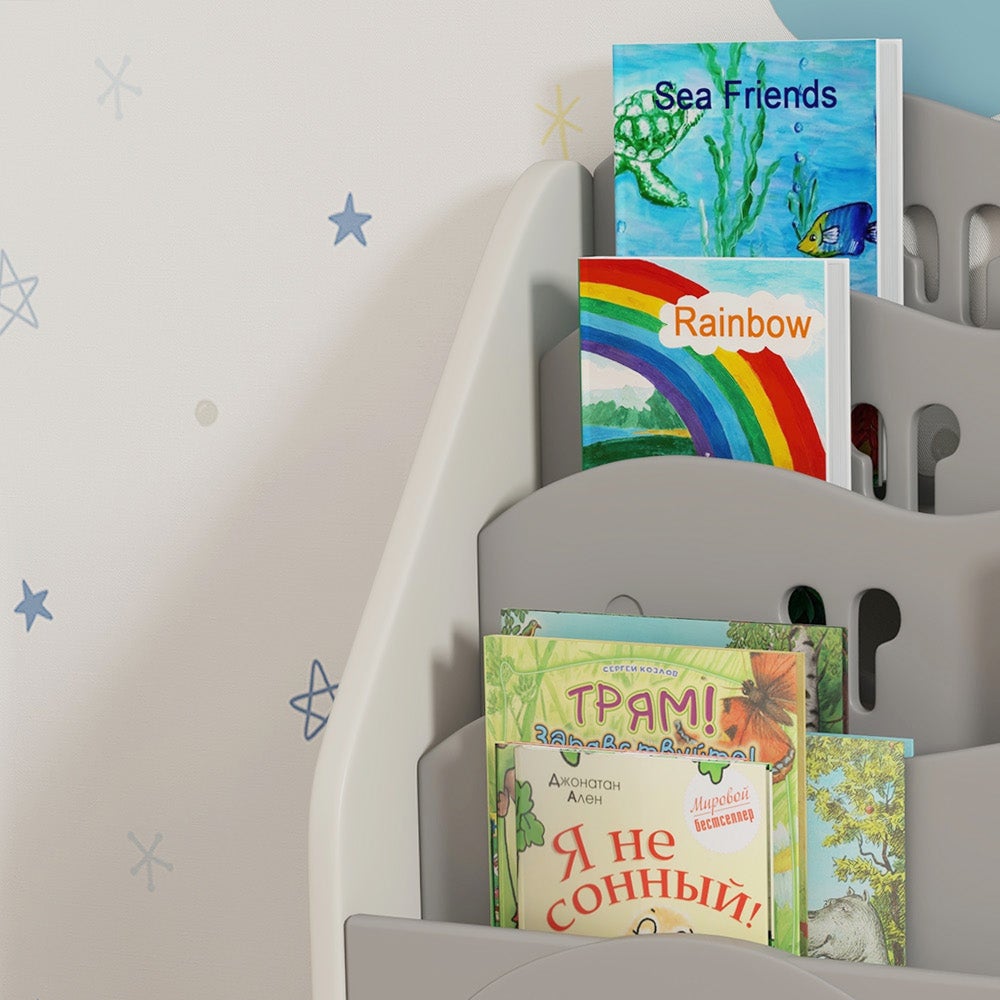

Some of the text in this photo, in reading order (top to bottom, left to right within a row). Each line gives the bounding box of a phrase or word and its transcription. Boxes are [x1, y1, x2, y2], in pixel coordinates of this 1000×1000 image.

[655, 79, 838, 110] Sea Friends
[674, 306, 812, 339] Rainbow
[602, 664, 679, 677] СЕРГЕЙ КОЗЛОВ
[568, 683, 714, 735] ТРЯМ!
[548, 772, 621, 791] Джонатан
[567, 790, 603, 805] Ален
[689, 786, 750, 816] Мировой
[552, 823, 675, 882] Я не
[546, 867, 762, 933] сонный!
